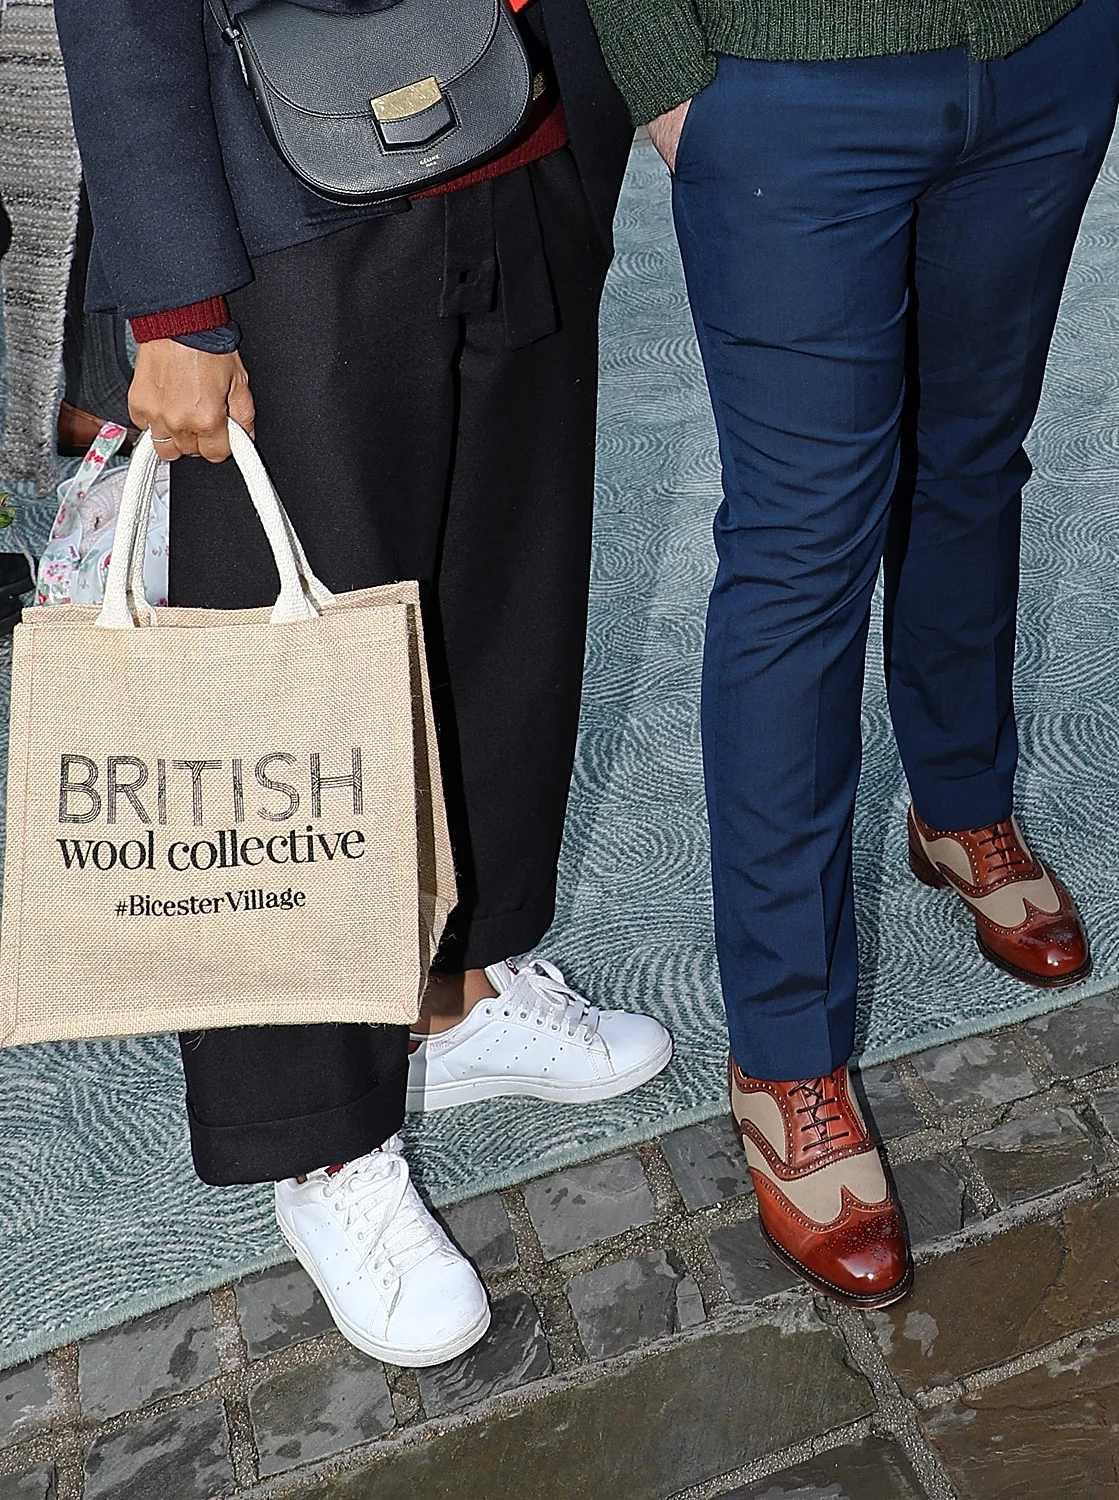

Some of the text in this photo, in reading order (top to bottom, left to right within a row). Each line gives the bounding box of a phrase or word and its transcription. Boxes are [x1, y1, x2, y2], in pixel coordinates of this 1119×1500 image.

[59, 748, 364, 825] BRITISH
[56, 826, 366, 872] wool collective
[115, 888, 307, 917] #BicesterVillage
